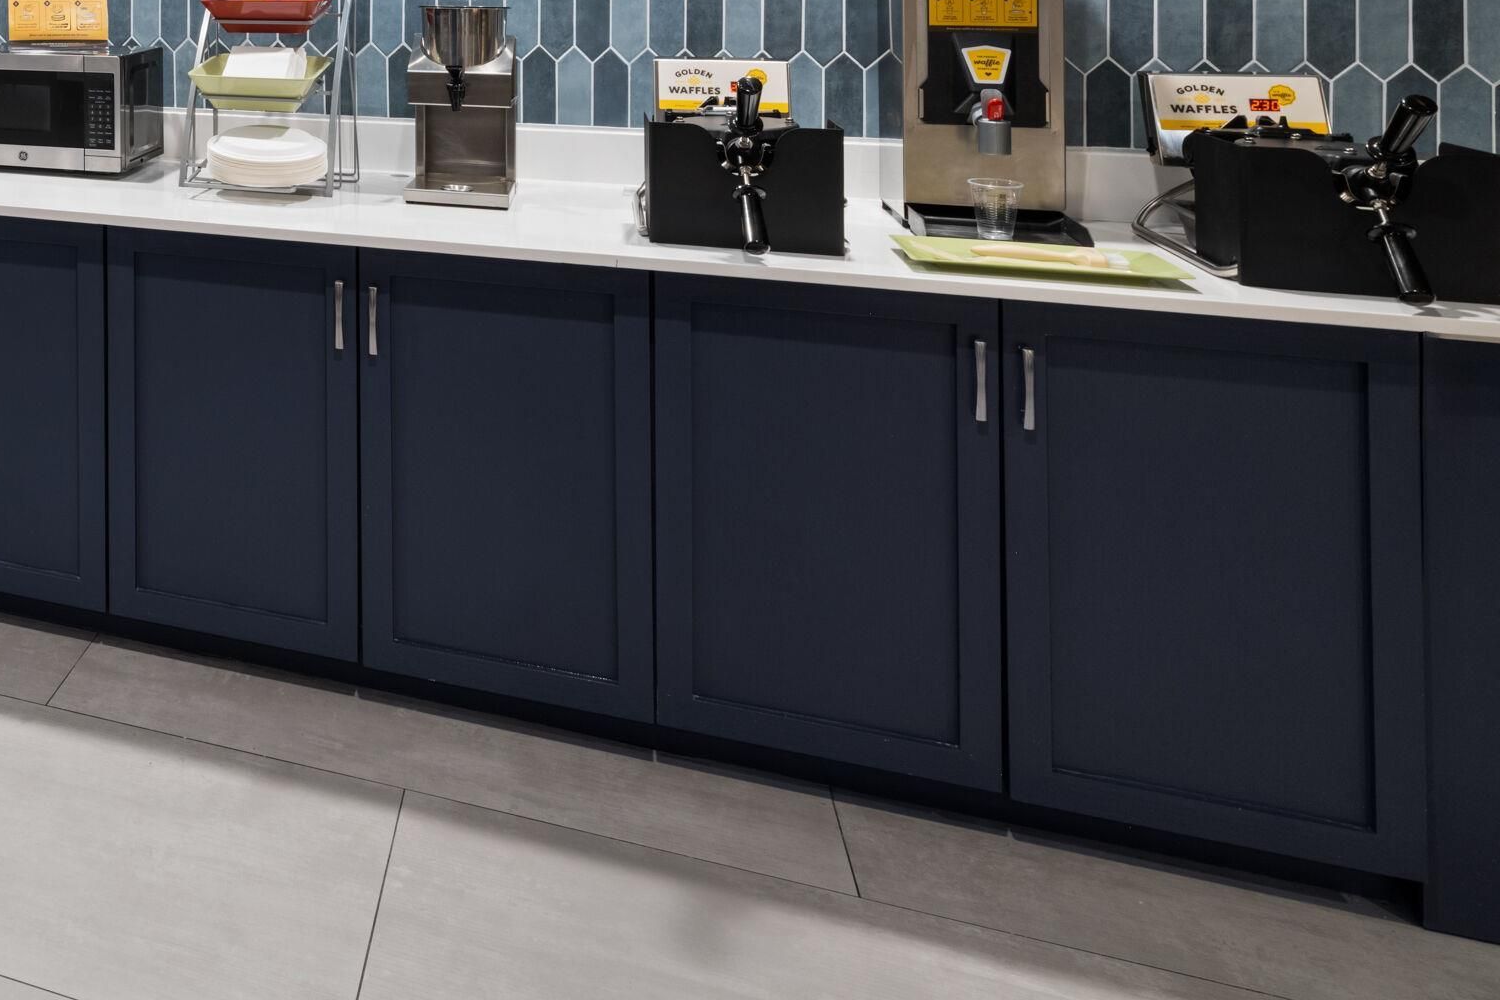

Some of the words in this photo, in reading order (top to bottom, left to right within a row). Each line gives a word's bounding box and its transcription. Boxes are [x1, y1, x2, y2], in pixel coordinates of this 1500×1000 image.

[674, 68, 713, 79] GOLDEN
[668, 86, 721, 95] WAFFLES
[1176, 84, 1225, 96] GOLDEN
[1170, 104, 1238, 114] WAFFLES
